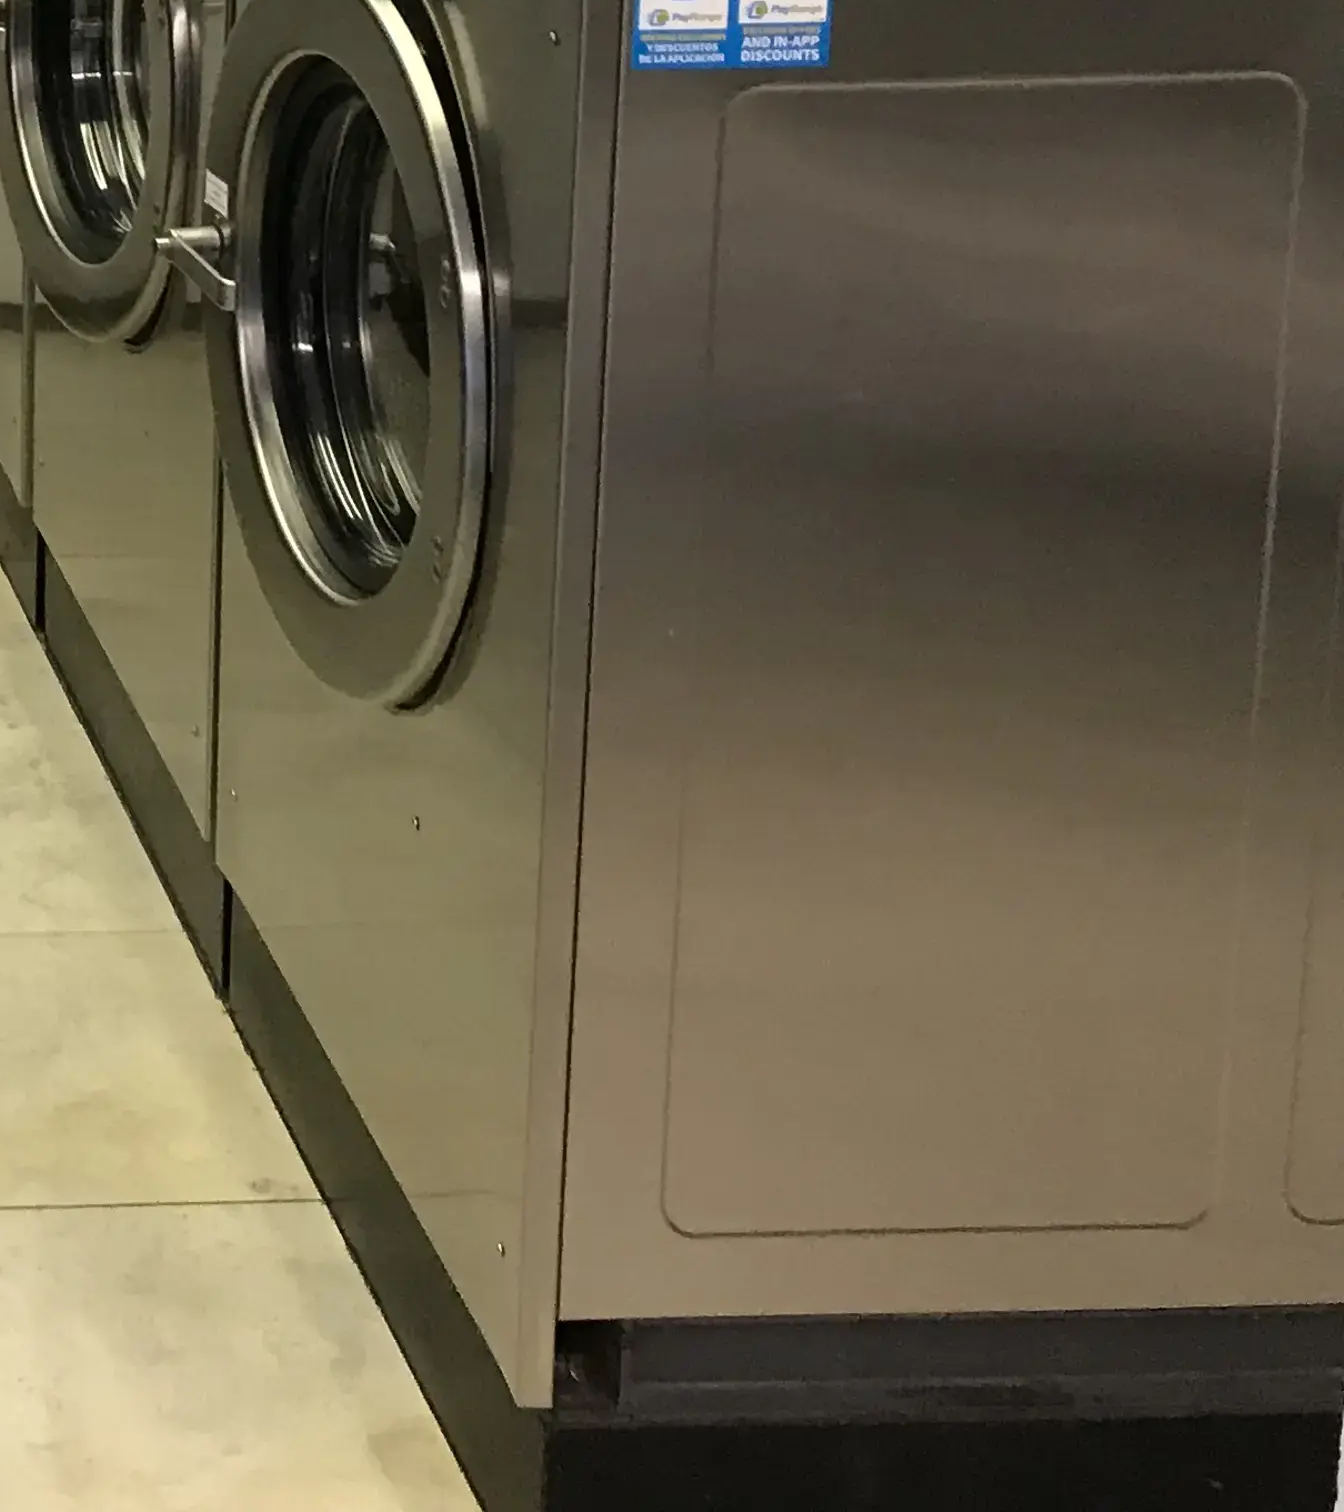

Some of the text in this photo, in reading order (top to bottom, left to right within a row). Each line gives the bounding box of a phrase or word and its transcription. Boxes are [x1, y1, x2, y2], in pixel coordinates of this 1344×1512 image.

[742, 35, 821, 48] AND IN-APP
[740, 48, 821, 62] DISCOUNTS
